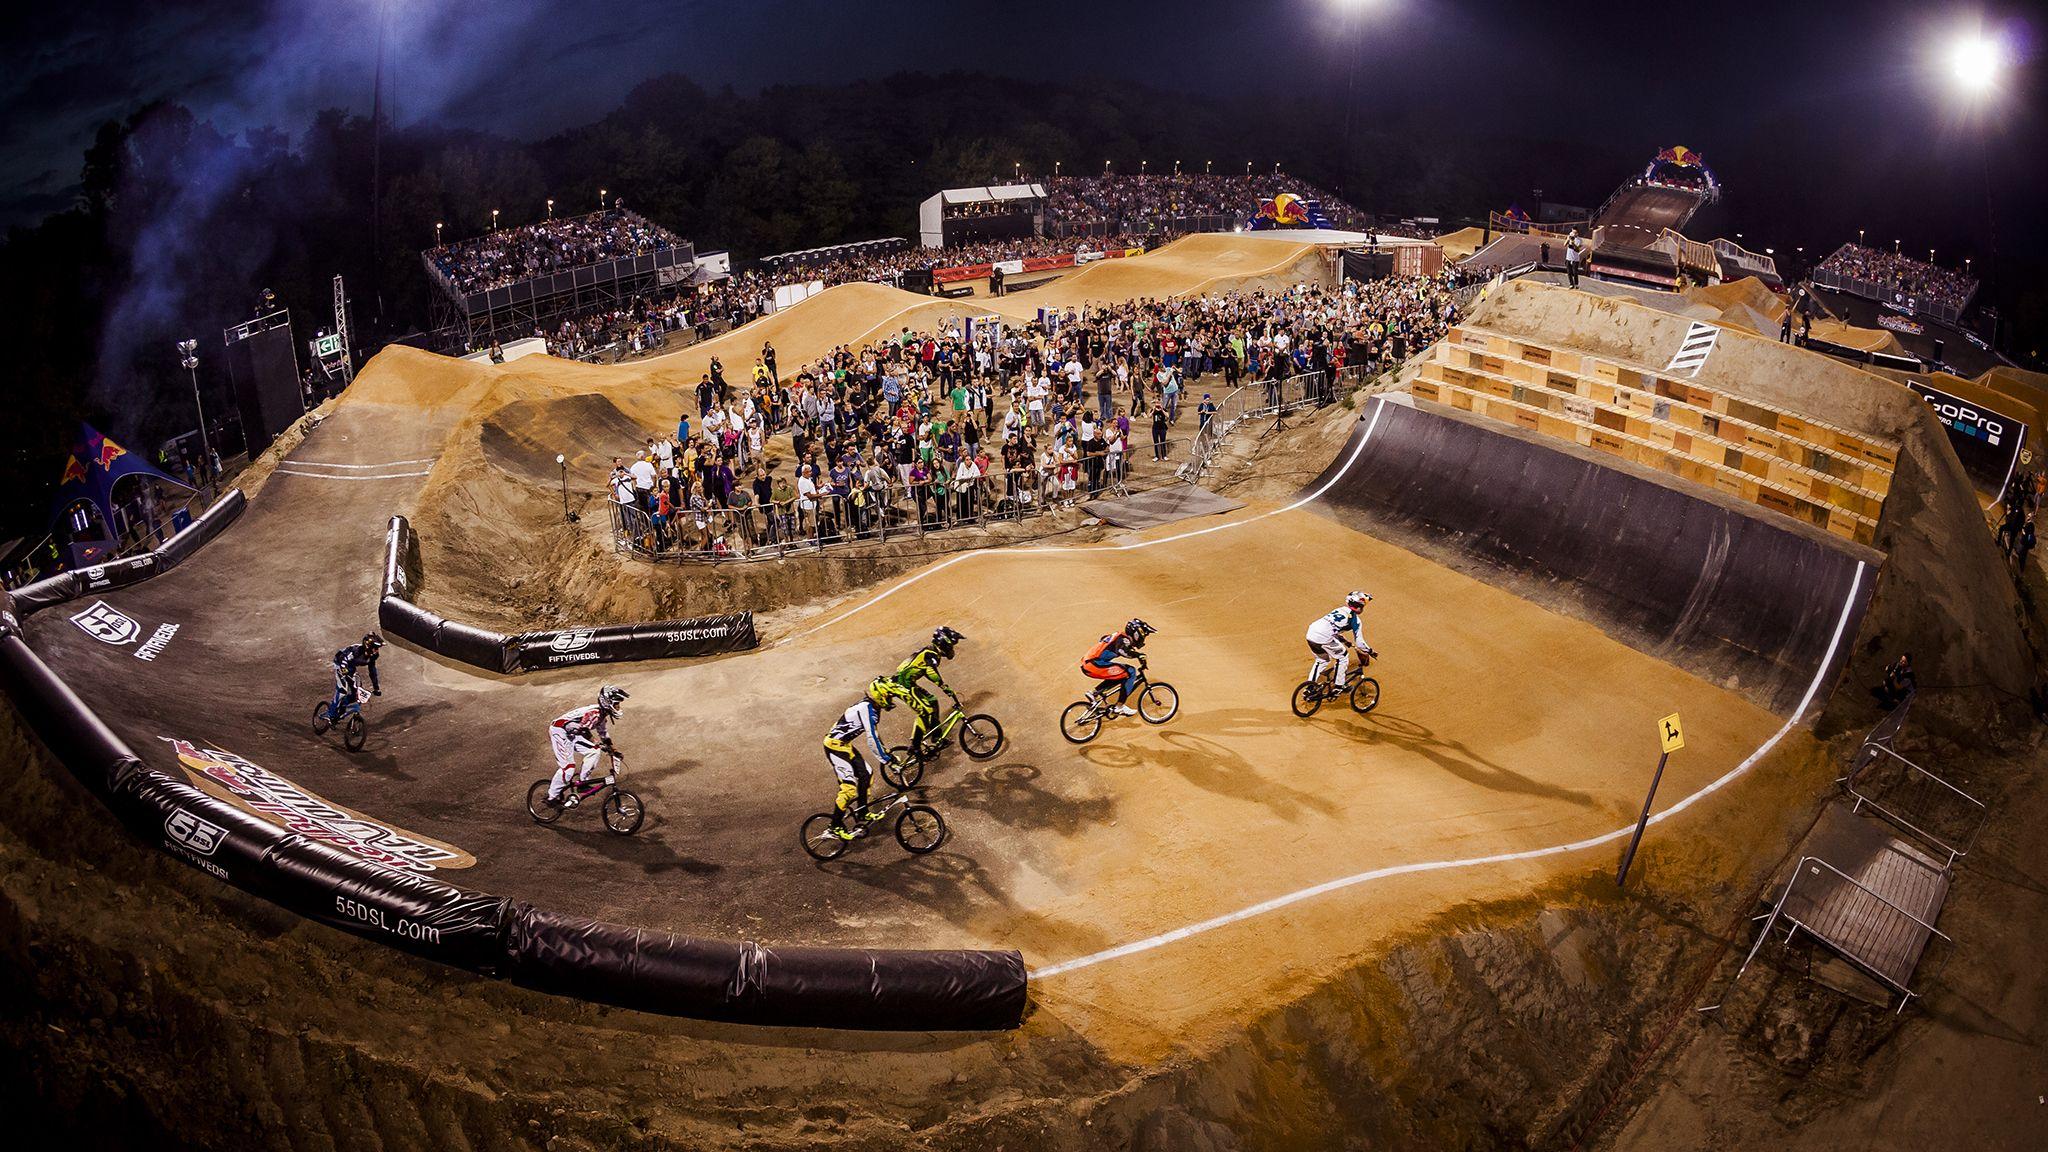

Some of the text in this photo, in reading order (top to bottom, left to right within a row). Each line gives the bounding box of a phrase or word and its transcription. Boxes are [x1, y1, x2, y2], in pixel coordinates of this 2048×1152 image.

[79, 607, 132, 641] 55
[110, 617, 128, 629] DSL
[133, 622, 180, 662] FIFTYFIVEDSL
[548, 652, 601, 662] FIFTYFIVEDSL
[167, 811, 219, 851] 55
[192, 835, 212, 849] DSL
[336, 895, 441, 945] 55DSL.com
